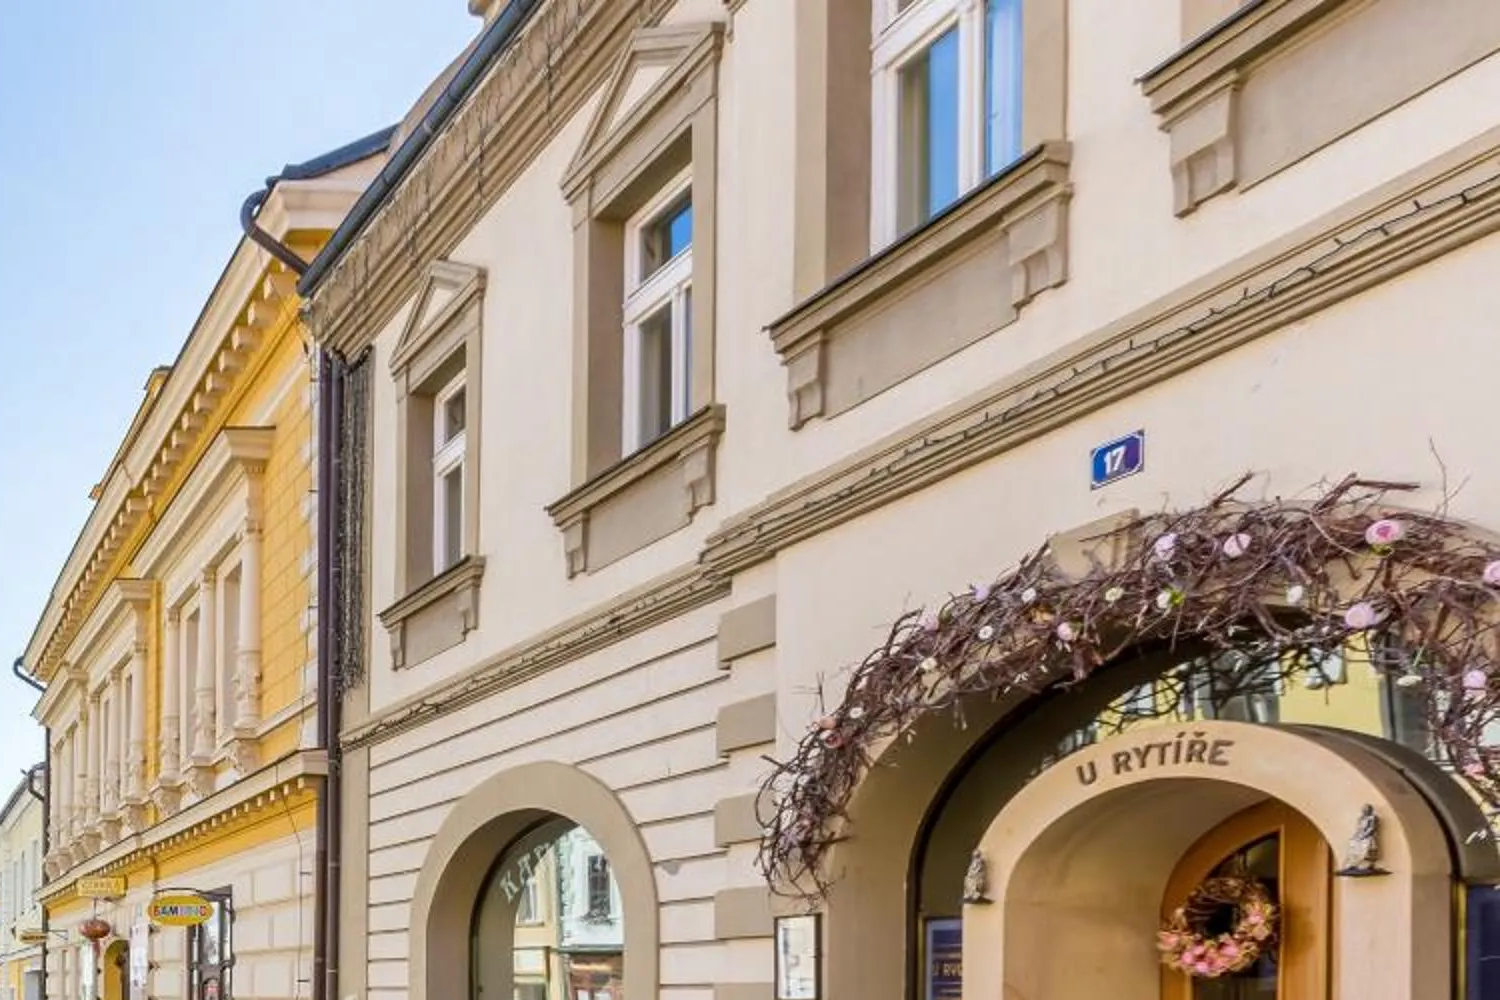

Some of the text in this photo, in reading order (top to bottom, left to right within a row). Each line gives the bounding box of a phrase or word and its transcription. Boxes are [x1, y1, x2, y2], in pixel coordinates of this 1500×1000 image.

[1104, 444, 1126, 475] 17
[1076, 731, 1235, 786] U RYTÍŘE
